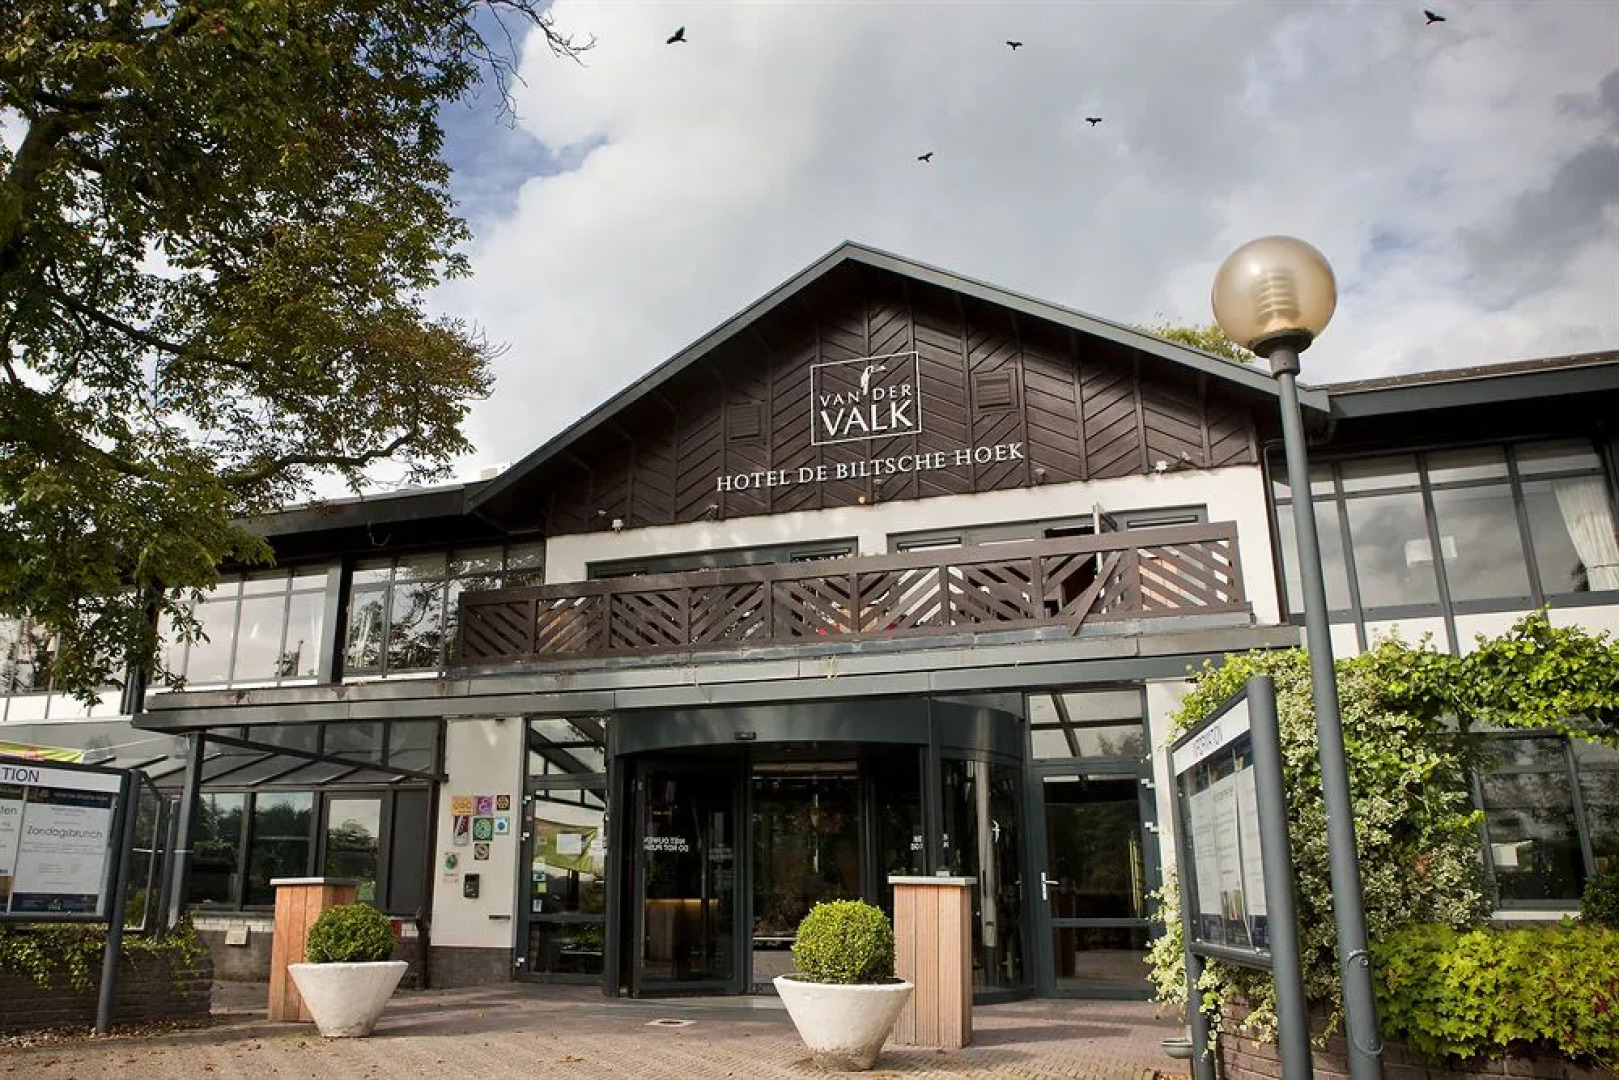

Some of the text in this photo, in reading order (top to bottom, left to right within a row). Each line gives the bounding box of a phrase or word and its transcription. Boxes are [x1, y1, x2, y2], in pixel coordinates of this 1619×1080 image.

[819, 383, 912, 407] VAN DER
[820, 399, 914, 436] VALK
[716, 441, 1024, 492] HOTEL DE BILTSCHE HOEK
